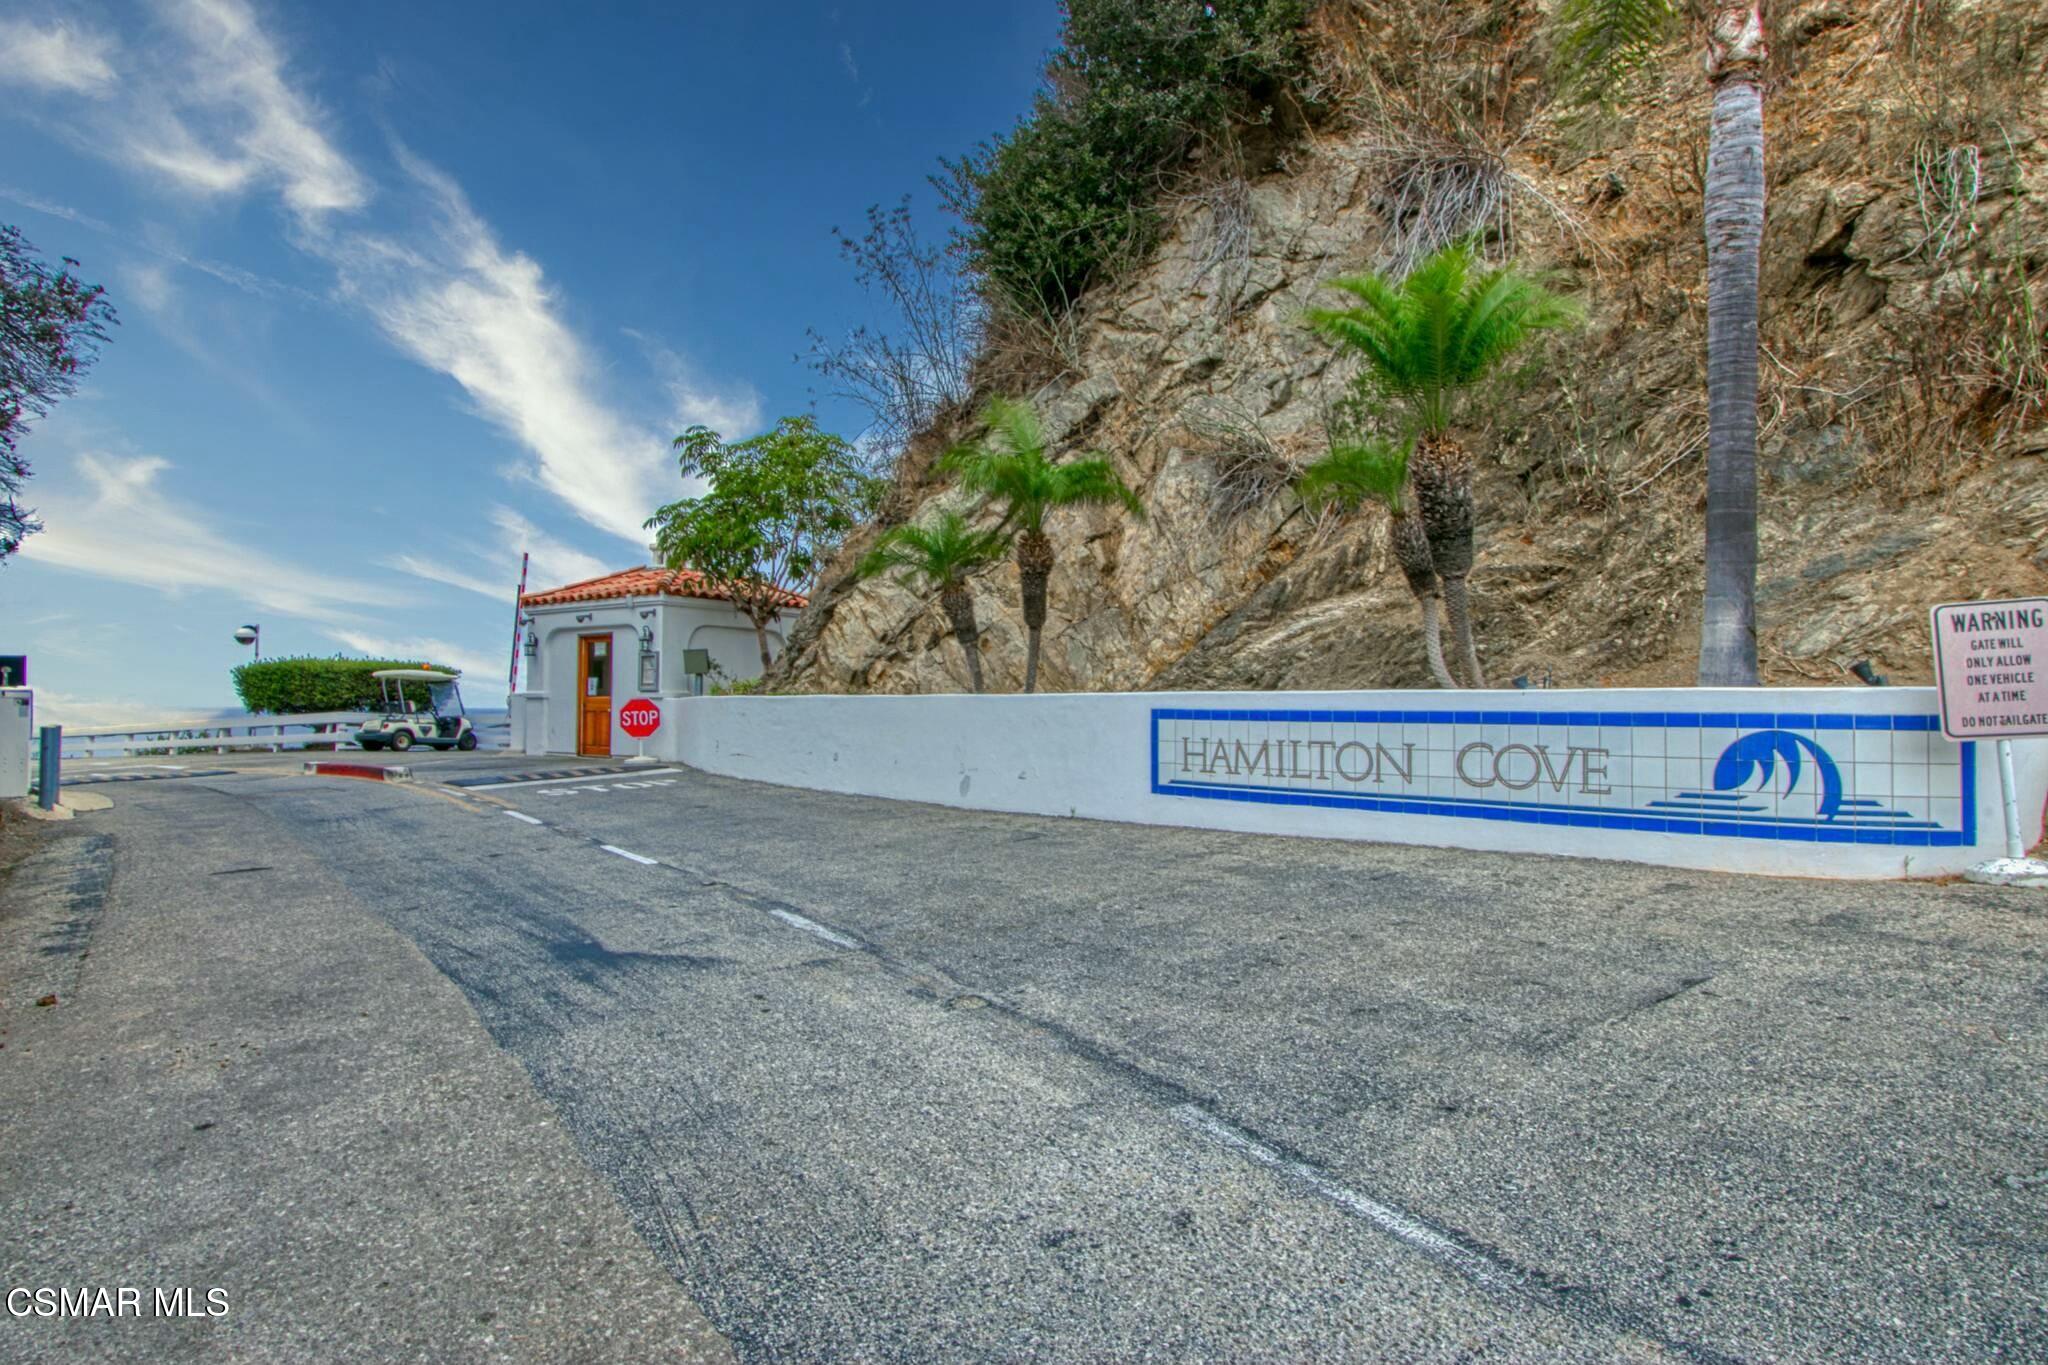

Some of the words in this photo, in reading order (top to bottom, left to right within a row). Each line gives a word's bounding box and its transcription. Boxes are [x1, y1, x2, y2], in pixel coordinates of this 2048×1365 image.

[1951, 608, 2043, 632] WARNING
[1970, 639, 1995, 651] GATE
[1998, 637, 2024, 649] WILL
[1966, 656, 1993, 669] ONLY
[1996, 654, 2031, 667] ALLOW
[1967, 675, 1987, 686] ONE
[1990, 672, 2034, 685] VEHICLE
[1978, 692, 1990, 703] AT
[1992, 692, 2000, 702] A
[2001, 690, 2027, 702] TIME
[622, 710, 659, 726] STOP
[1962, 716, 1976, 728] DO
[1978, 715, 1998, 727] NOT
[1999, 713, 2048, 726] TAILGATE
[1181, 736, 1416, 784] HAMILTON
[1456, 741, 1612, 795] COVE
